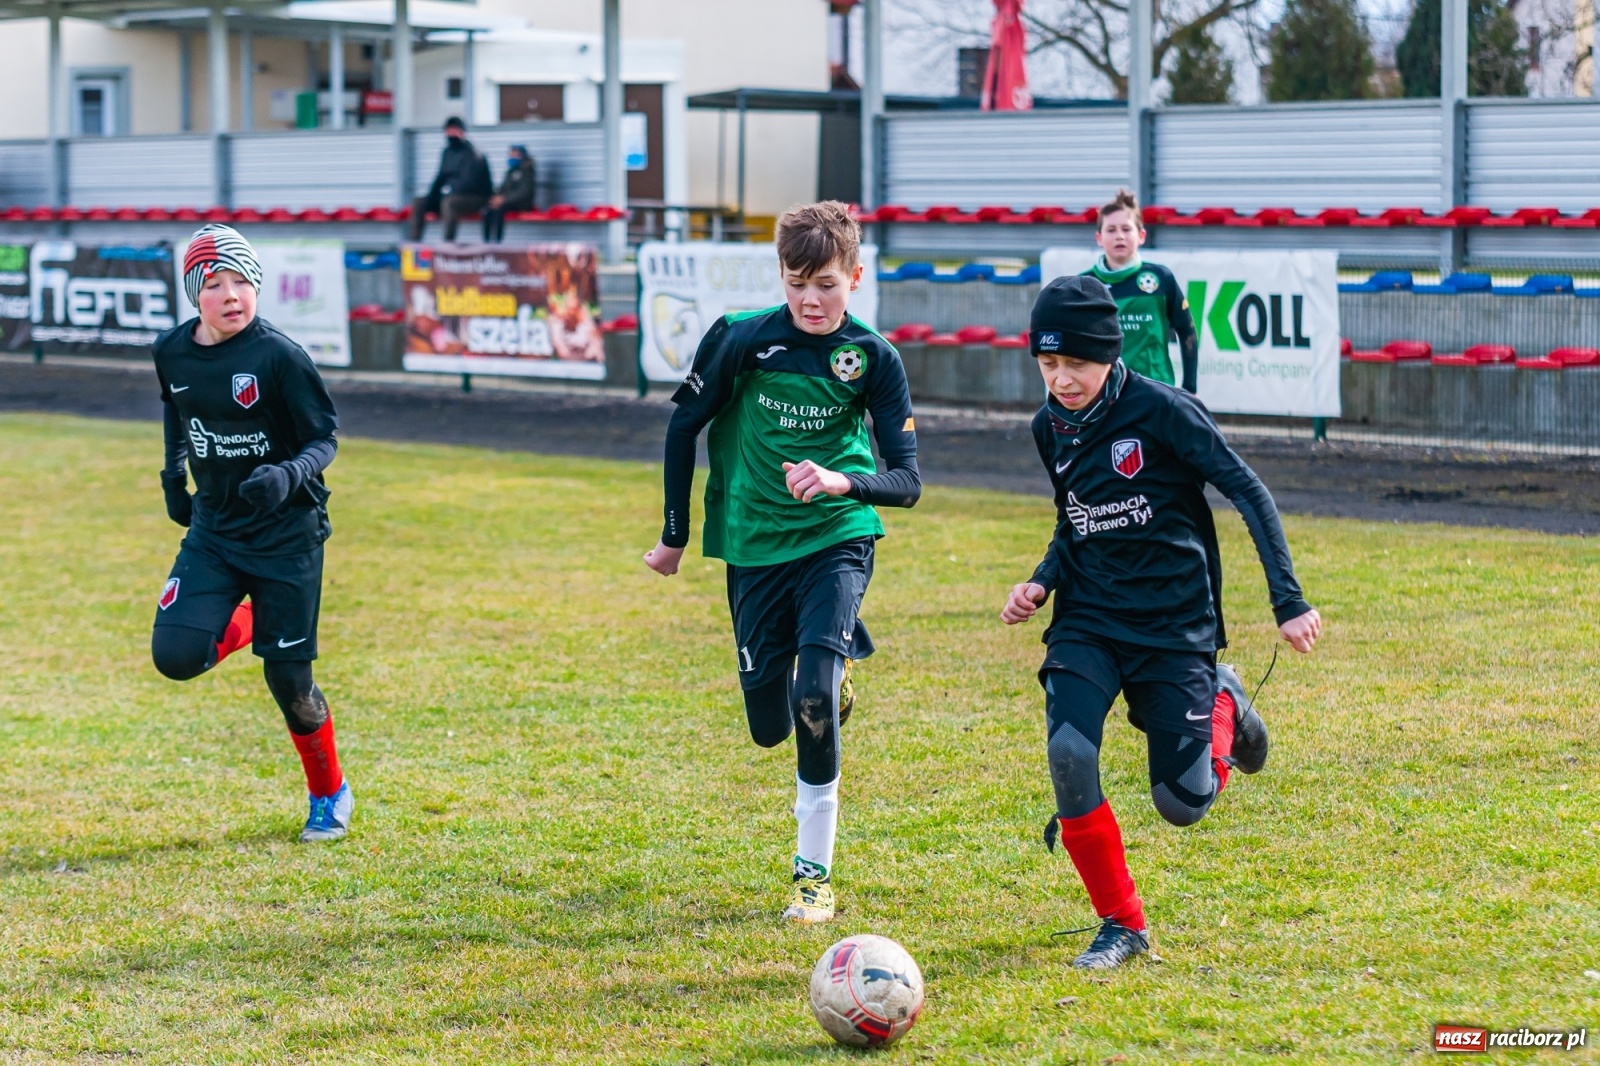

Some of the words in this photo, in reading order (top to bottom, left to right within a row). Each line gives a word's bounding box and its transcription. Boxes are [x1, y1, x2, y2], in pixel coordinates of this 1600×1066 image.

[1200, 356, 1244, 381] uilding
[757, 392, 848, 418] RESTAURACJ
[779, 415, 825, 431] BRAVO
[249, 440, 271, 457] Ty!
[1091, 494, 1148, 518] FUNDACJA
[669, 509, 677, 535] KIPSTA
[1088, 516, 1129, 533] Brawo
[1129, 506, 1153, 525] Ty!
